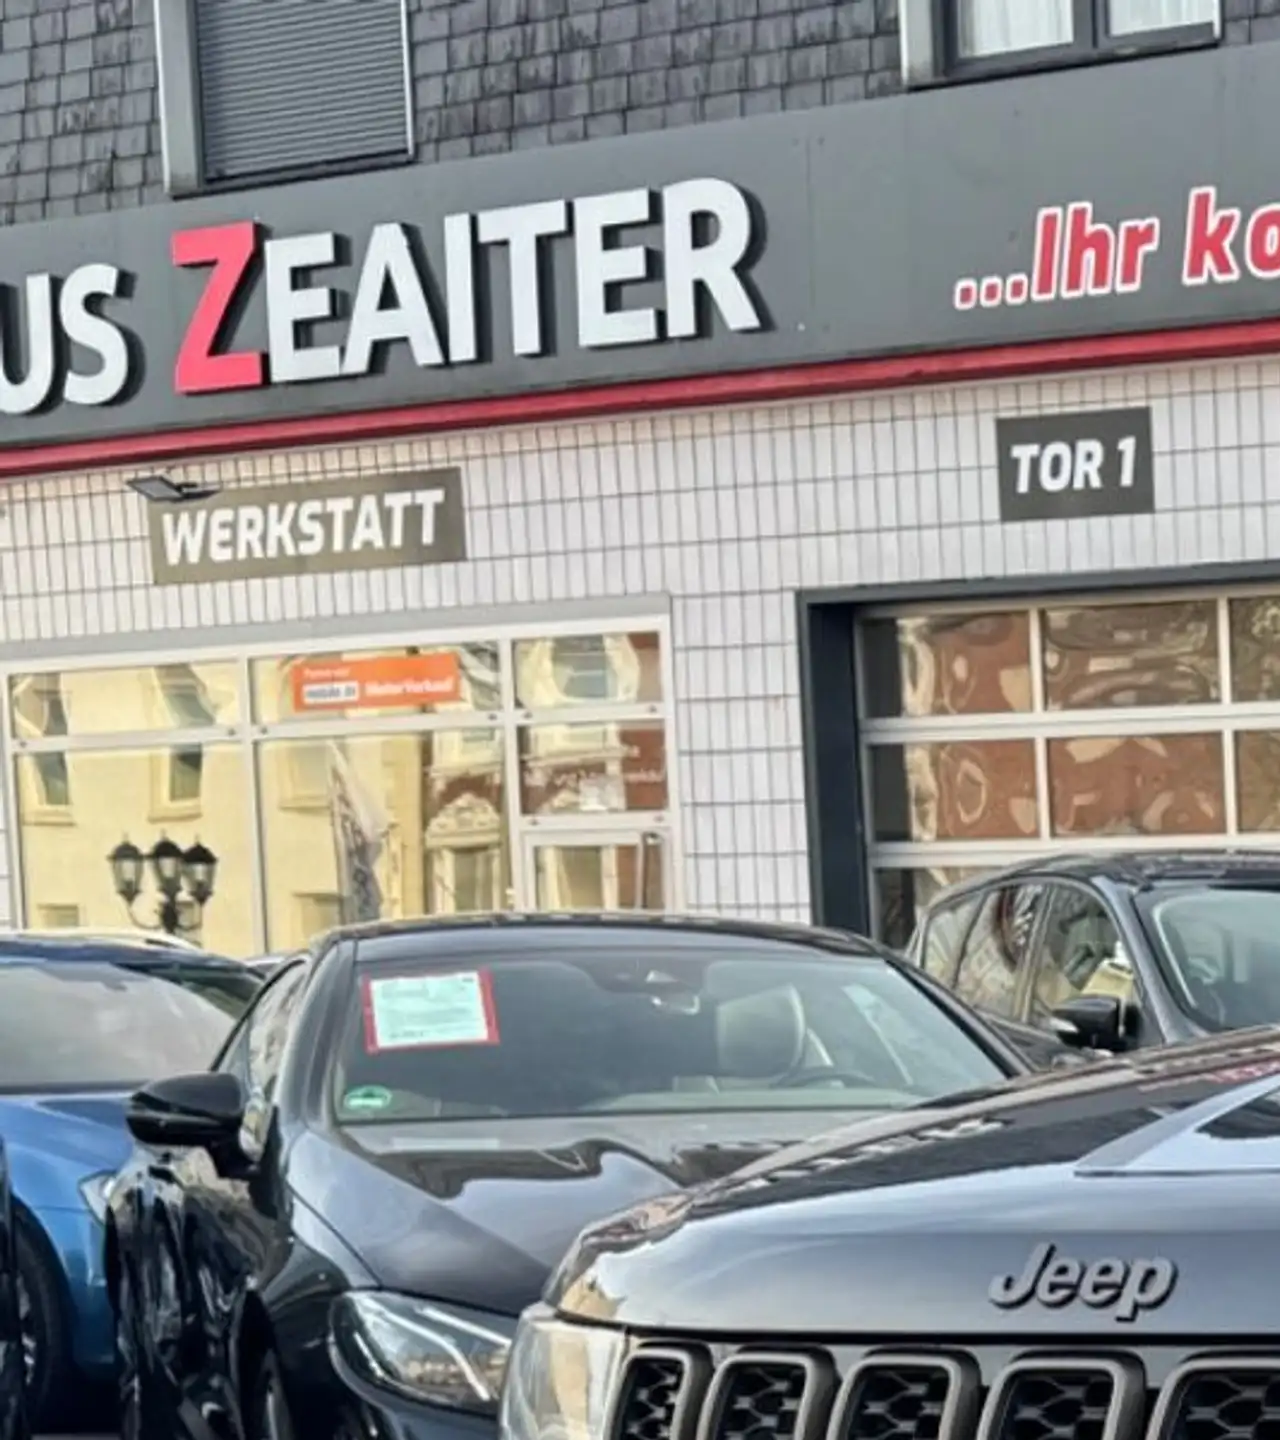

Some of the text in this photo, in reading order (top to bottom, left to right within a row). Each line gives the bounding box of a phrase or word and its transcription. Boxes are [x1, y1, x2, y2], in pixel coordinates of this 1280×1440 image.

[171, 178, 761, 393] ZEAITER
[1011, 436, 1136, 493] TOR 1
[162, 489, 446, 566] WERKSTATT
[986, 1241, 1179, 1324] Jeep
